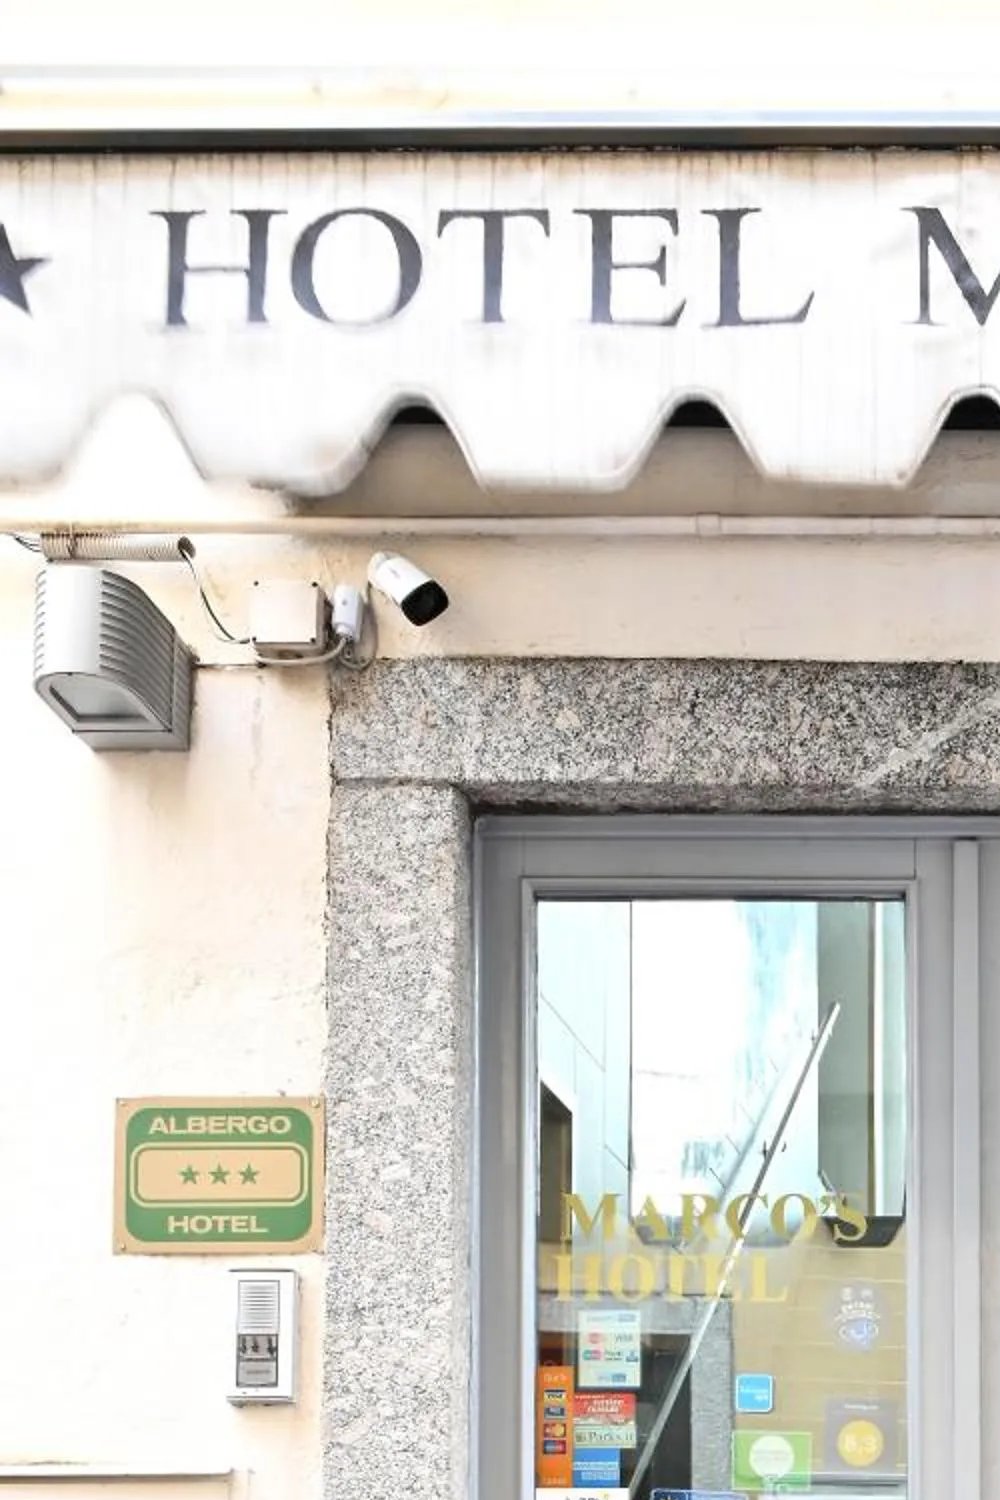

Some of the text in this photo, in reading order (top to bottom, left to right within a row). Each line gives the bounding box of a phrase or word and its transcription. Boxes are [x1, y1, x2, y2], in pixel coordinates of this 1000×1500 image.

[150, 207, 814, 328] HOTEL
[148, 1115, 292, 1135] ALBERGO
[167, 1215, 269, 1234] HOTEL
[561, 1192, 868, 1242] MARCO'S
[552, 1254, 788, 1303] HOTEL
